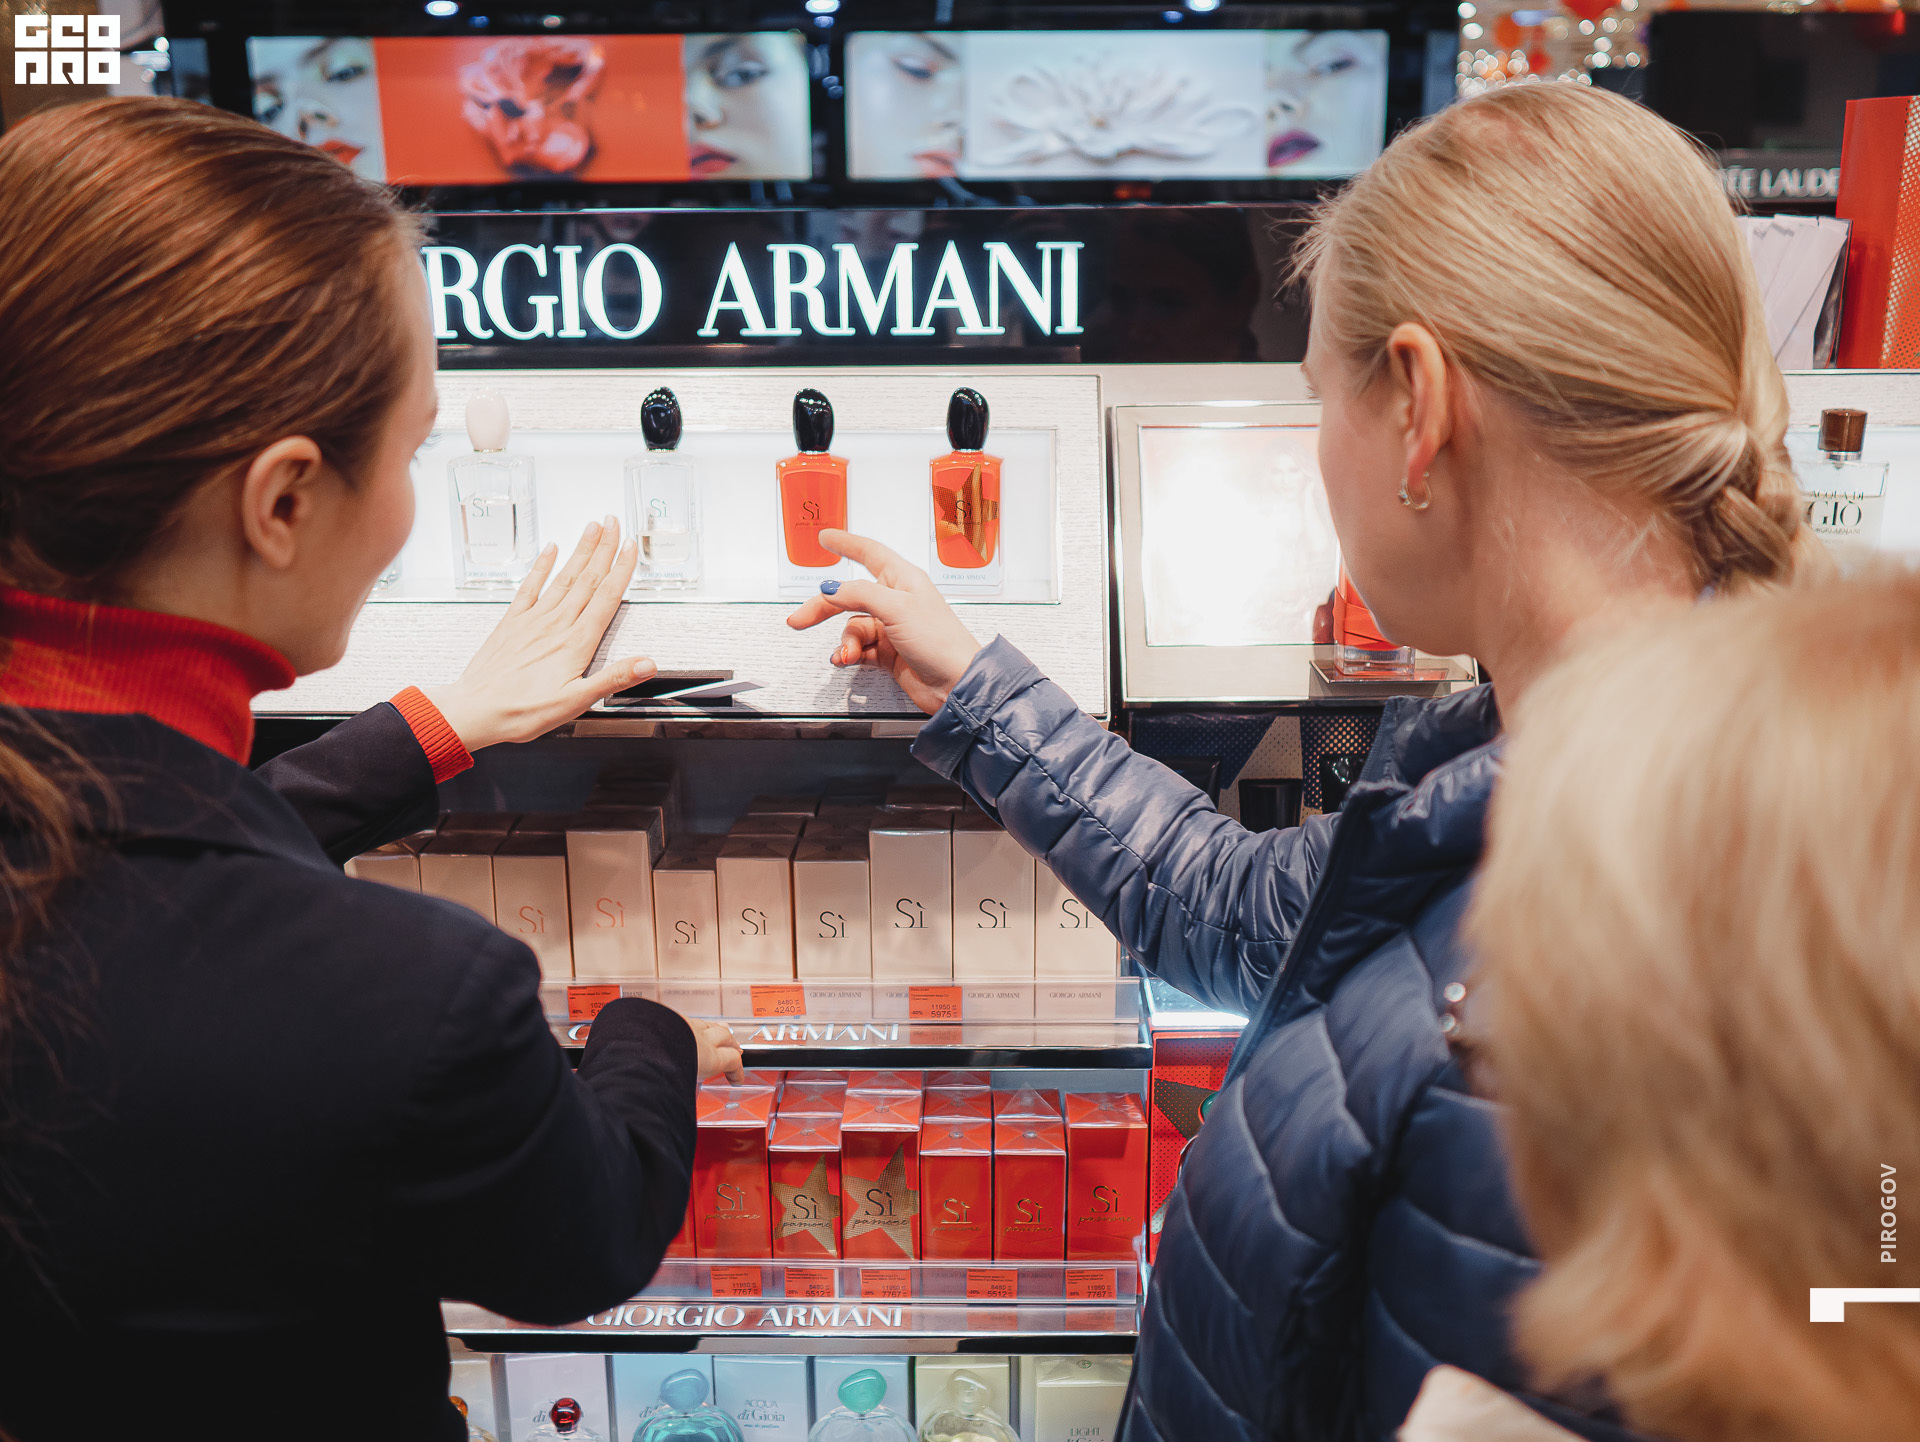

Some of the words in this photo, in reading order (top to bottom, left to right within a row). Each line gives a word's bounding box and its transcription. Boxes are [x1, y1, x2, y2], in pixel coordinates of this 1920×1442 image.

[697, 240, 1085, 337] ARMANI
[649, 498, 669, 518] Sì
[802, 500, 822, 520] Sì
[518, 905, 545, 934] Sì
[596, 897, 627, 928] Sì
[740, 908, 770, 935] Sì
[818, 910, 848, 938] Sì
[894, 898, 927, 928] Sì
[977, 898, 1010, 928] Sì
[674, 920, 700, 944] Sì
[774, 1005, 796, 1014] 4240
[930, 1010, 952, 1018] 5975
[748, 1023, 899, 1041] ARMANI
[716, 1183, 748, 1211] Sì
[792, 1194, 822, 1219] Sì
[865, 1188, 896, 1216] Sì
[1090, 1185, 1121, 1213] Sì
[941, 1198, 972, 1224] Sì
[1015, 1198, 1044, 1224] Sì
[781, 1220, 831, 1229] passione
[852, 1219, 910, 1229] passione
[987, 1290, 1007, 1298] 5512
[586, 1305, 745, 1327] GIORGIO
[757, 1305, 903, 1327] ARMANI
[737, 1409, 751, 1421] di
[752, 1409, 785, 1422] Gioia
[745, 1400, 779, 1408] ACQUA
[1070, 1427, 1100, 1436] LIGHT
